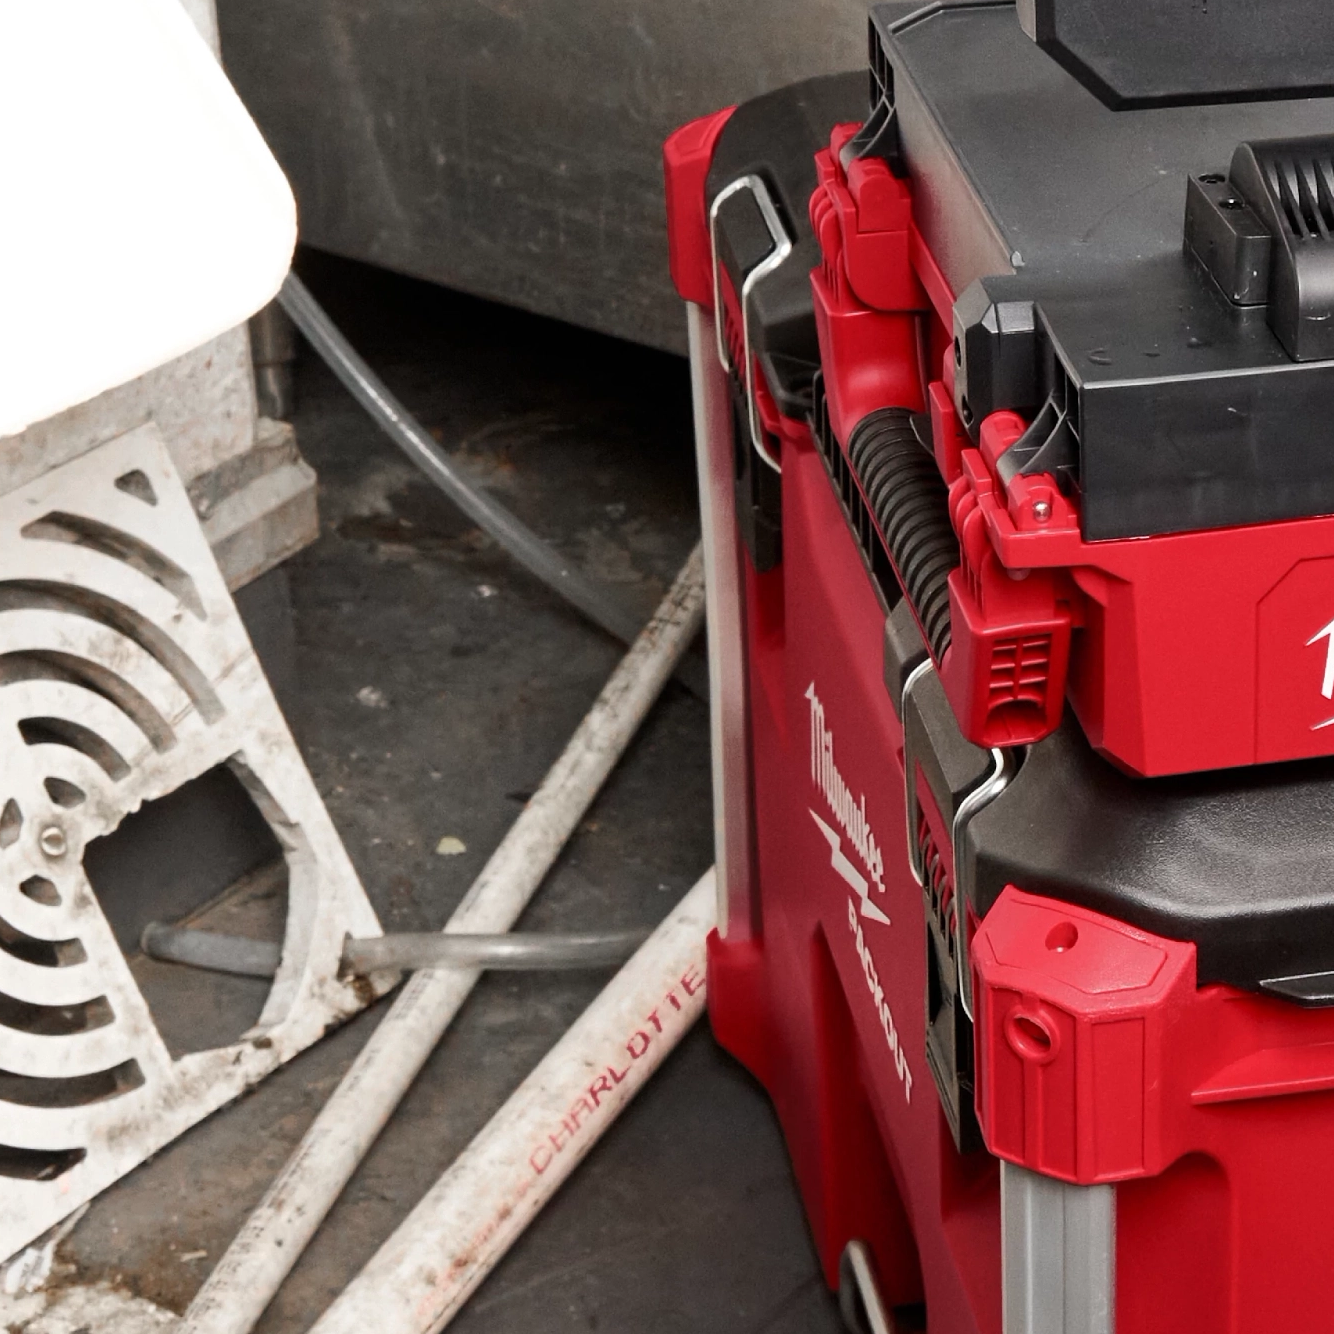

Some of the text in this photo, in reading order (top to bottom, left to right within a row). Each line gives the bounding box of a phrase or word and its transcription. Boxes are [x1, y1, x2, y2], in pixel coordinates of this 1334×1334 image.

[804, 679, 886, 893] Milwaukee
[529, 963, 706, 1176] CHARLOTTE
[847, 894, 913, 1105] PACKOUT
